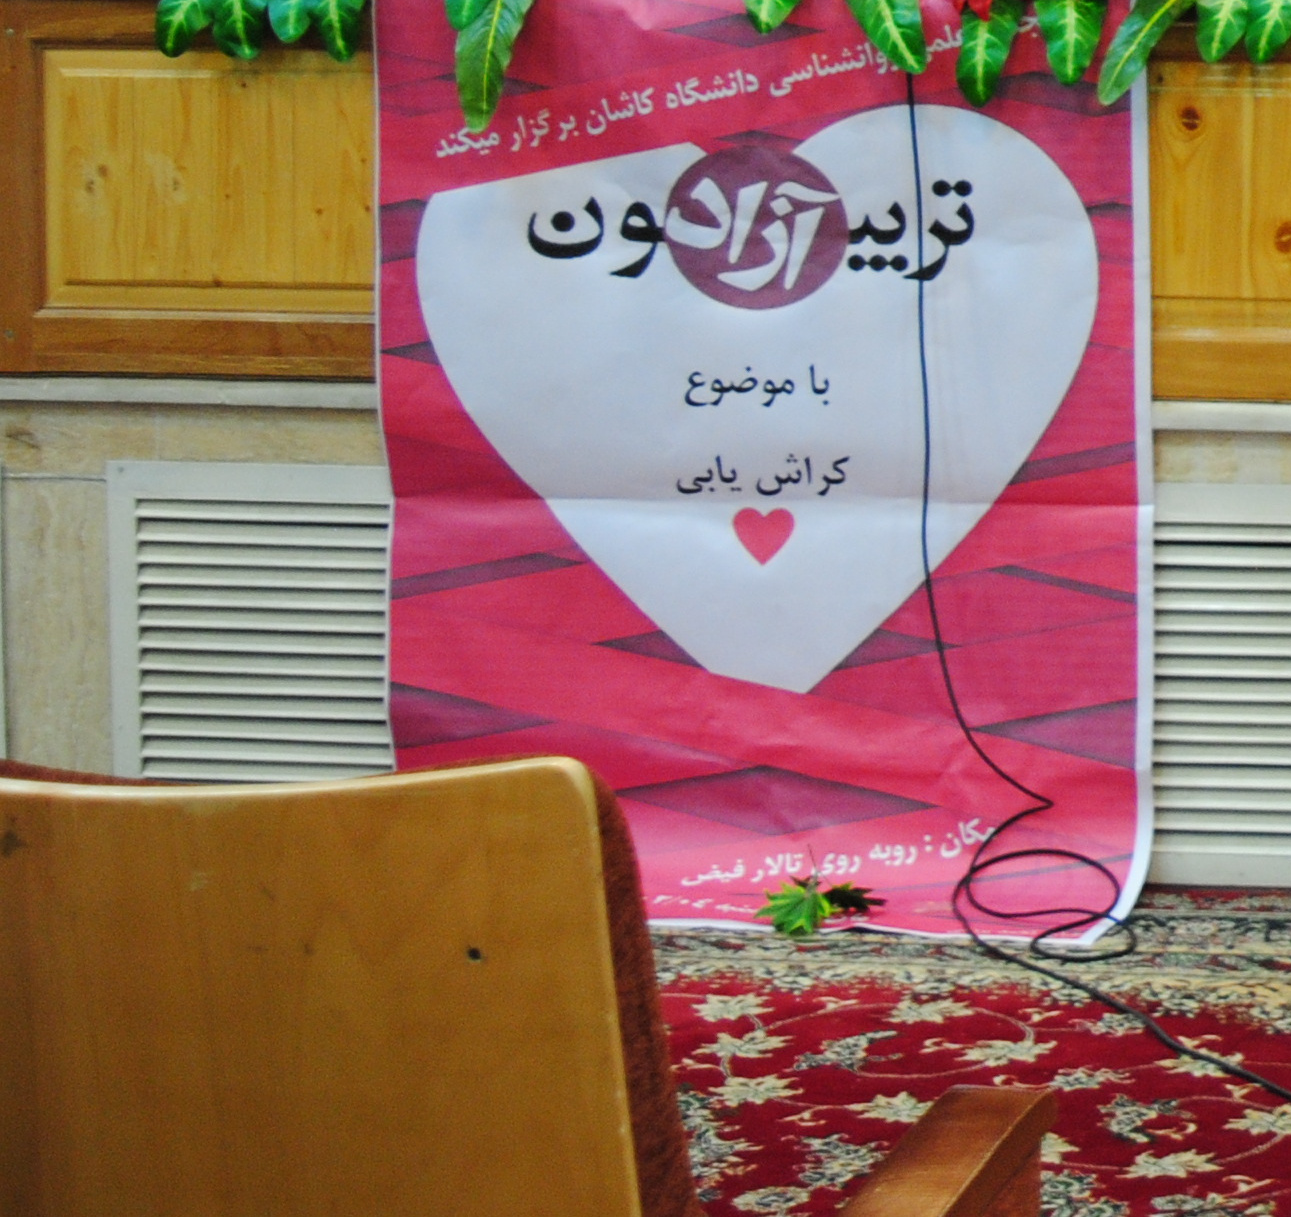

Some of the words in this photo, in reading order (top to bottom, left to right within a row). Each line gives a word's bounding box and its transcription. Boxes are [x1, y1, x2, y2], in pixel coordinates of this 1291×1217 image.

[665, 69, 760, 110] دانشگاه
[586, 87, 654, 135] کاشان
[435, 128, 500, 158] میکند
[664, 177, 840, 291] آزاد
[684, 365, 795, 407] موضوع
[808, 364, 830, 406] با
[676, 455, 738, 495] یابی
[756, 454, 850, 495] کراش
[940, 818, 997, 858] مکان
[751, 852, 804, 883] تالار
